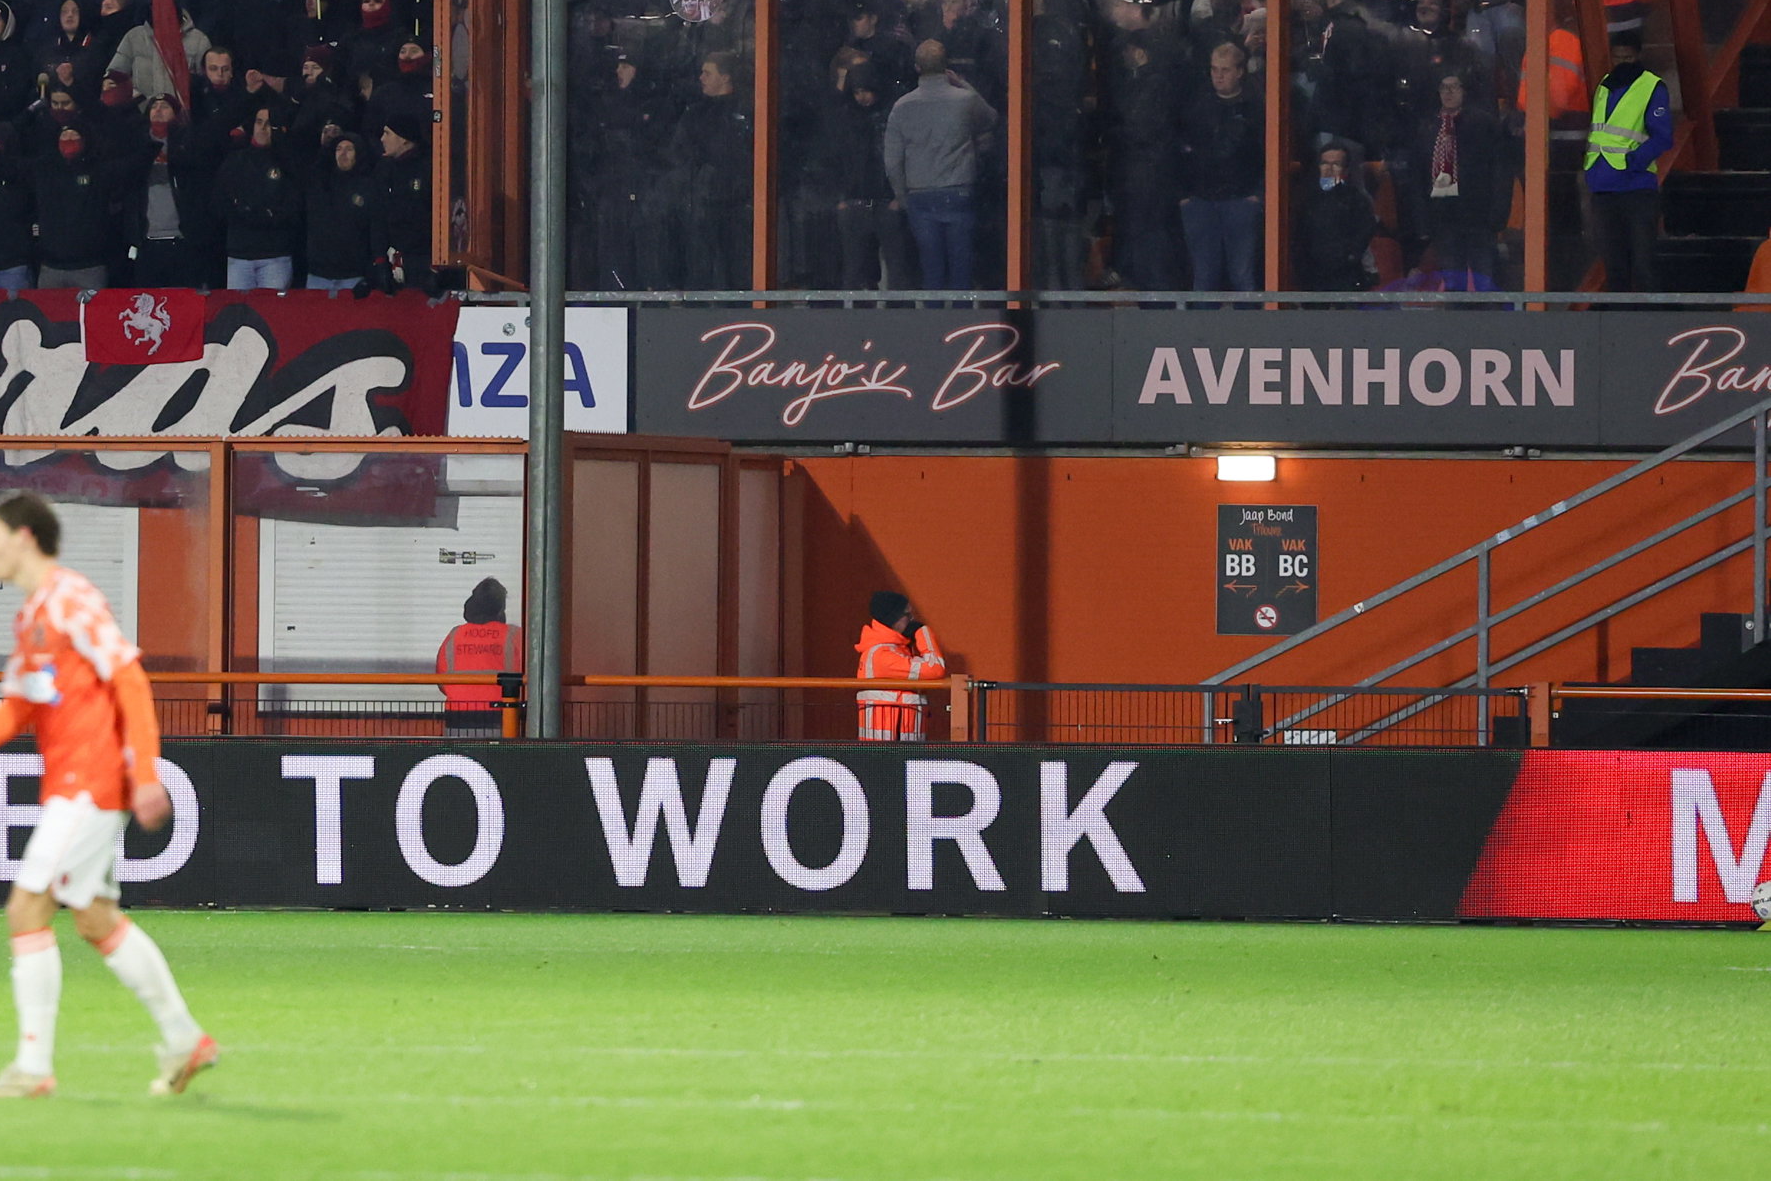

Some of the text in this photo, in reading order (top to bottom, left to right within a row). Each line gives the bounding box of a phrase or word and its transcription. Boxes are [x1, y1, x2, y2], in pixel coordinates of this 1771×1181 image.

[688, 322, 1060, 425] Banjo's Bar
[1138, 347, 1574, 407] AVENHORN
[1240, 508, 1294, 525] Jaap Bond
[1229, 538, 1306, 551] VAK VAK
[1226, 554, 1309, 577] BB BC
[456, 643, 503, 655] STEWARD
[280, 754, 1146, 893] TO WORK
